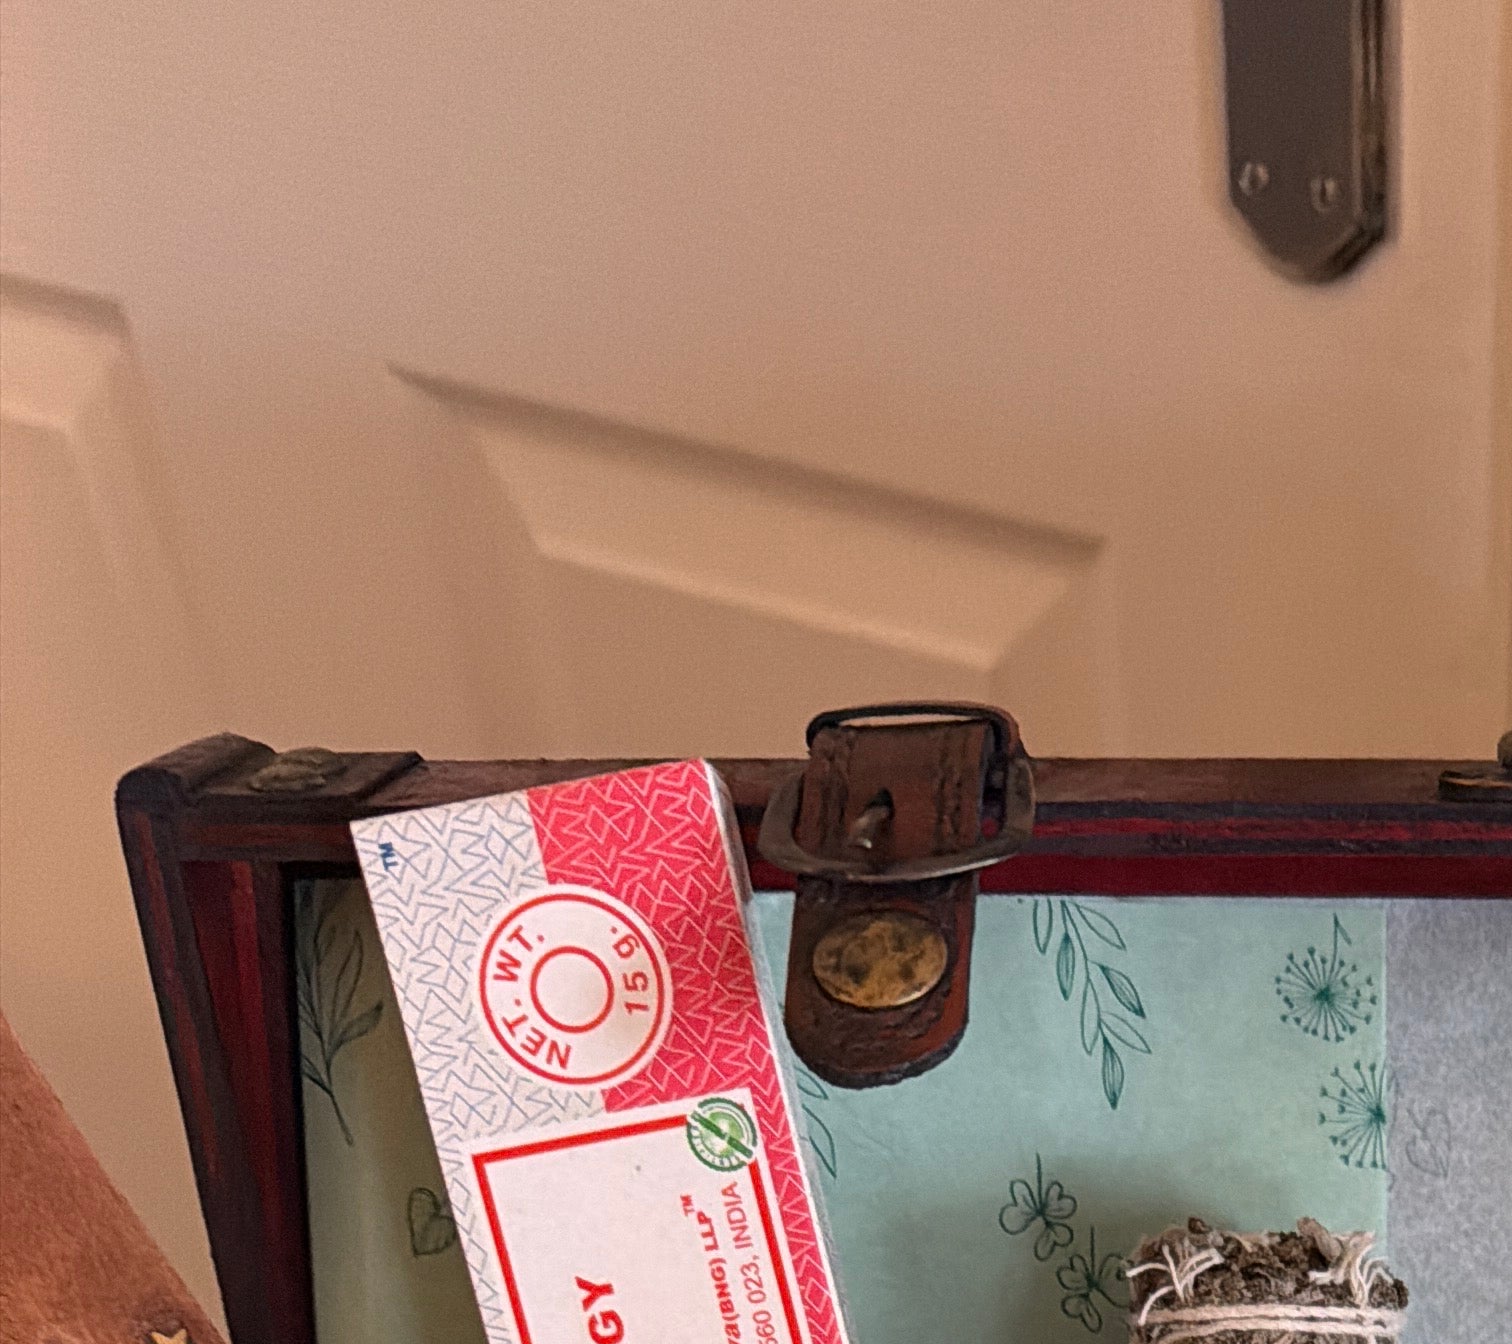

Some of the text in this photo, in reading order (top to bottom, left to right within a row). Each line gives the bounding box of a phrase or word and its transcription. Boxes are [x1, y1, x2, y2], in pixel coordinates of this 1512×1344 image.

[493, 925, 571, 1069] NET. WT.
[609, 926, 649, 1016] 15 g.
[722, 1181, 753, 1249] INDIA
[740, 1254, 766, 1304] 023,
